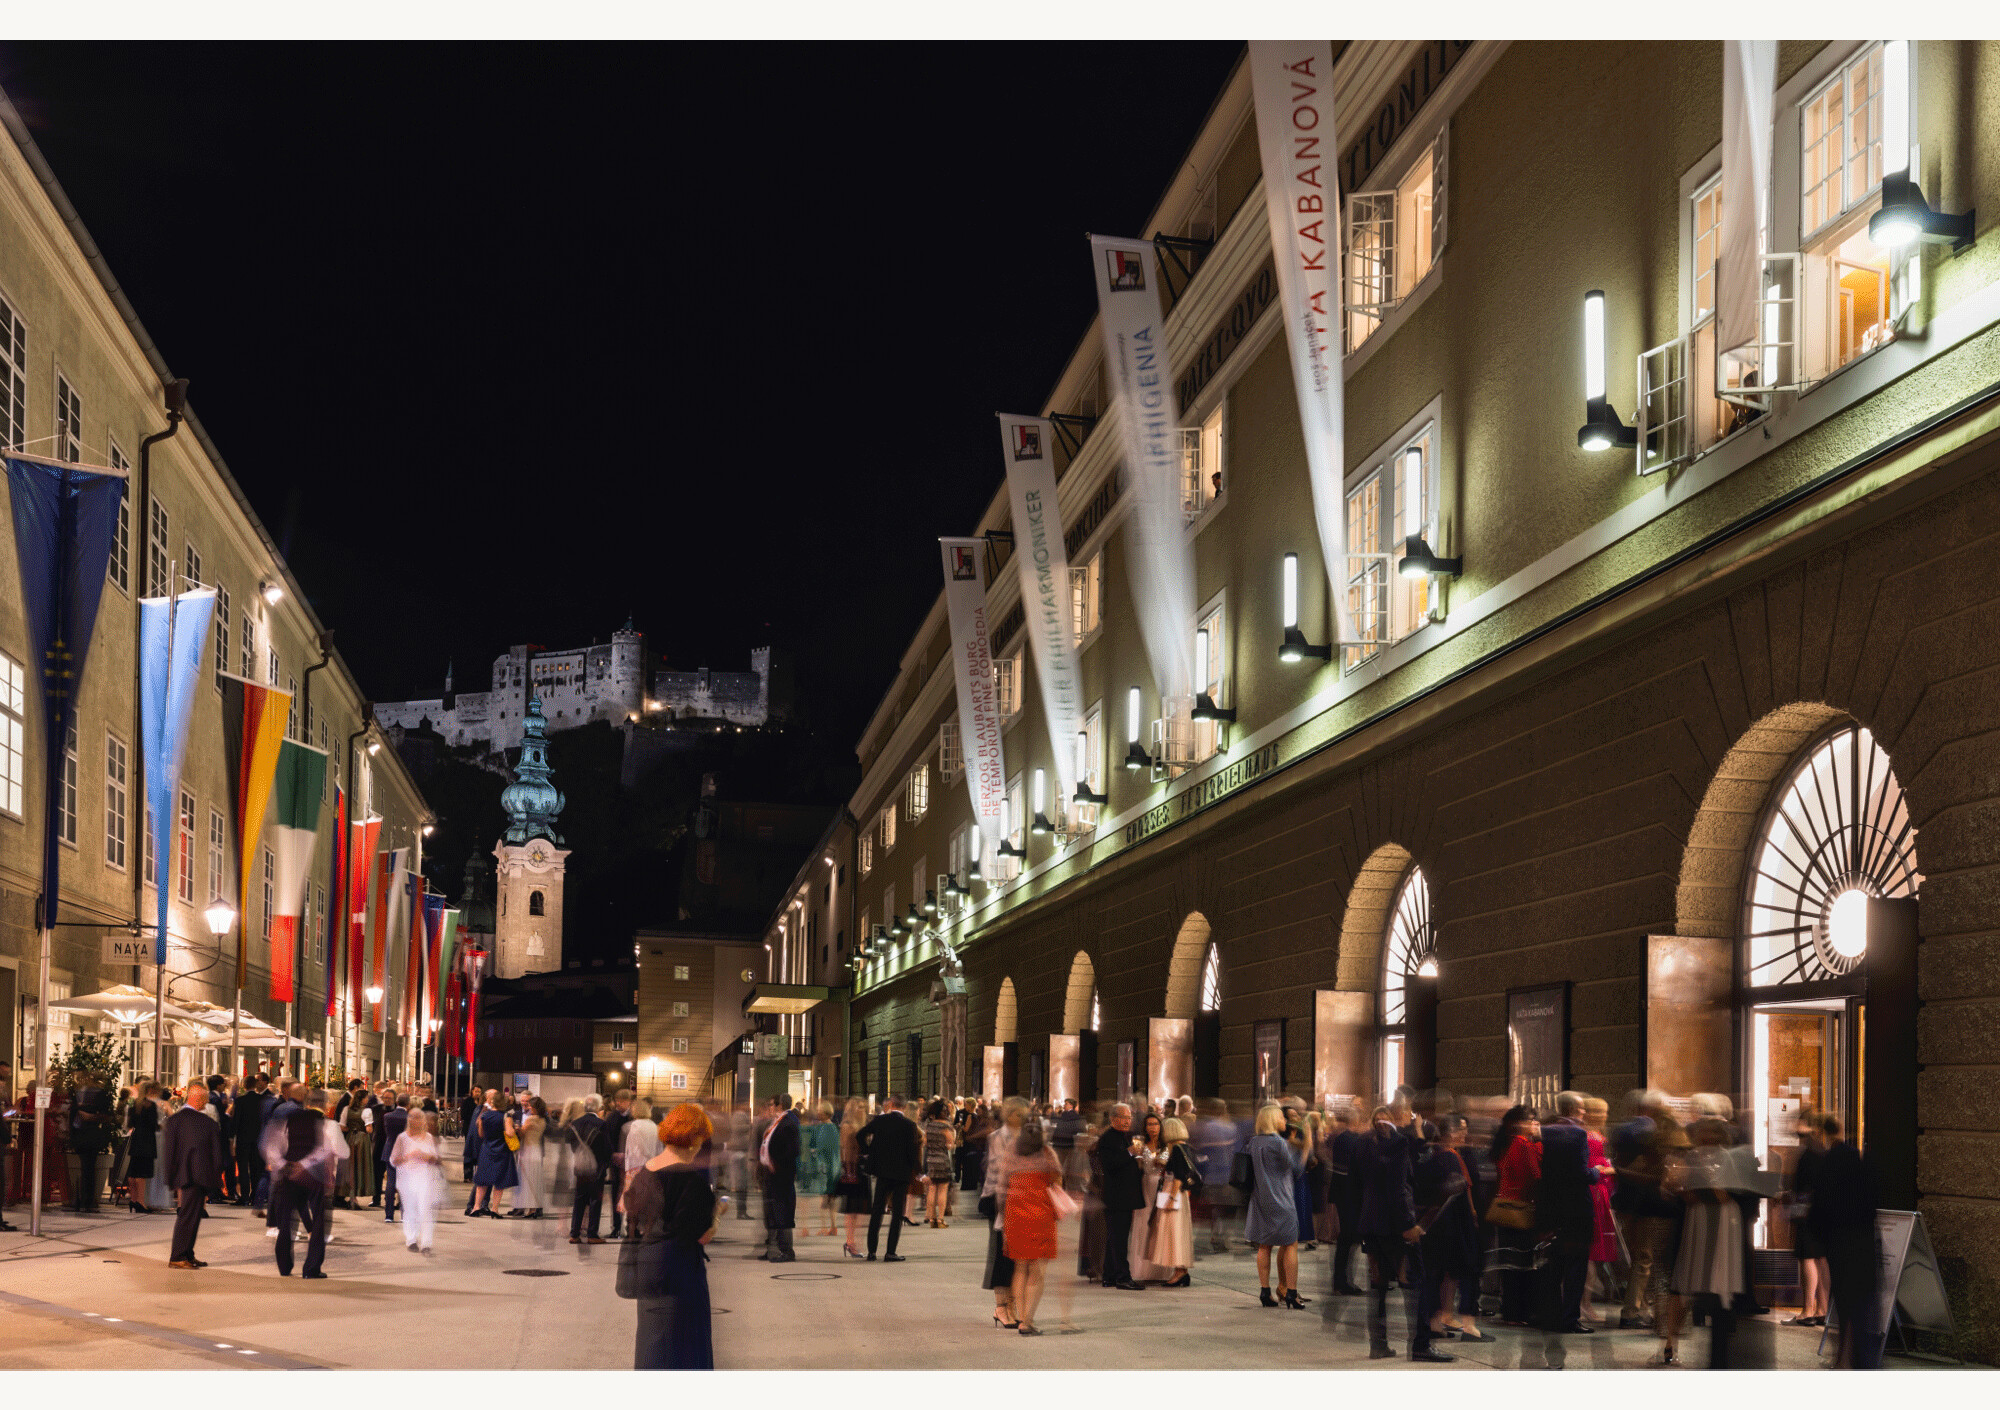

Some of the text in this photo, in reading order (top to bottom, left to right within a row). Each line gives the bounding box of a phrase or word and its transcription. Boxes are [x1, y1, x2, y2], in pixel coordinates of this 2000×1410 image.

[1283, 56, 1327, 271] KABANOVÁ
[1133, 326, 1174, 467] IPHIGENIA
[1026, 488, 1069, 671] PHILHARMONIKER
[974, 607, 990, 678] COMOEDIA
[967, 641, 991, 817] HERZOG BLAUBARTS BURG
[981, 683, 993, 712] FINE
[985, 717, 1001, 795] TEMPORUM
[1181, 743, 1279, 812] FESTSPIELHAUS
[114, 942, 148, 955] NAYA
